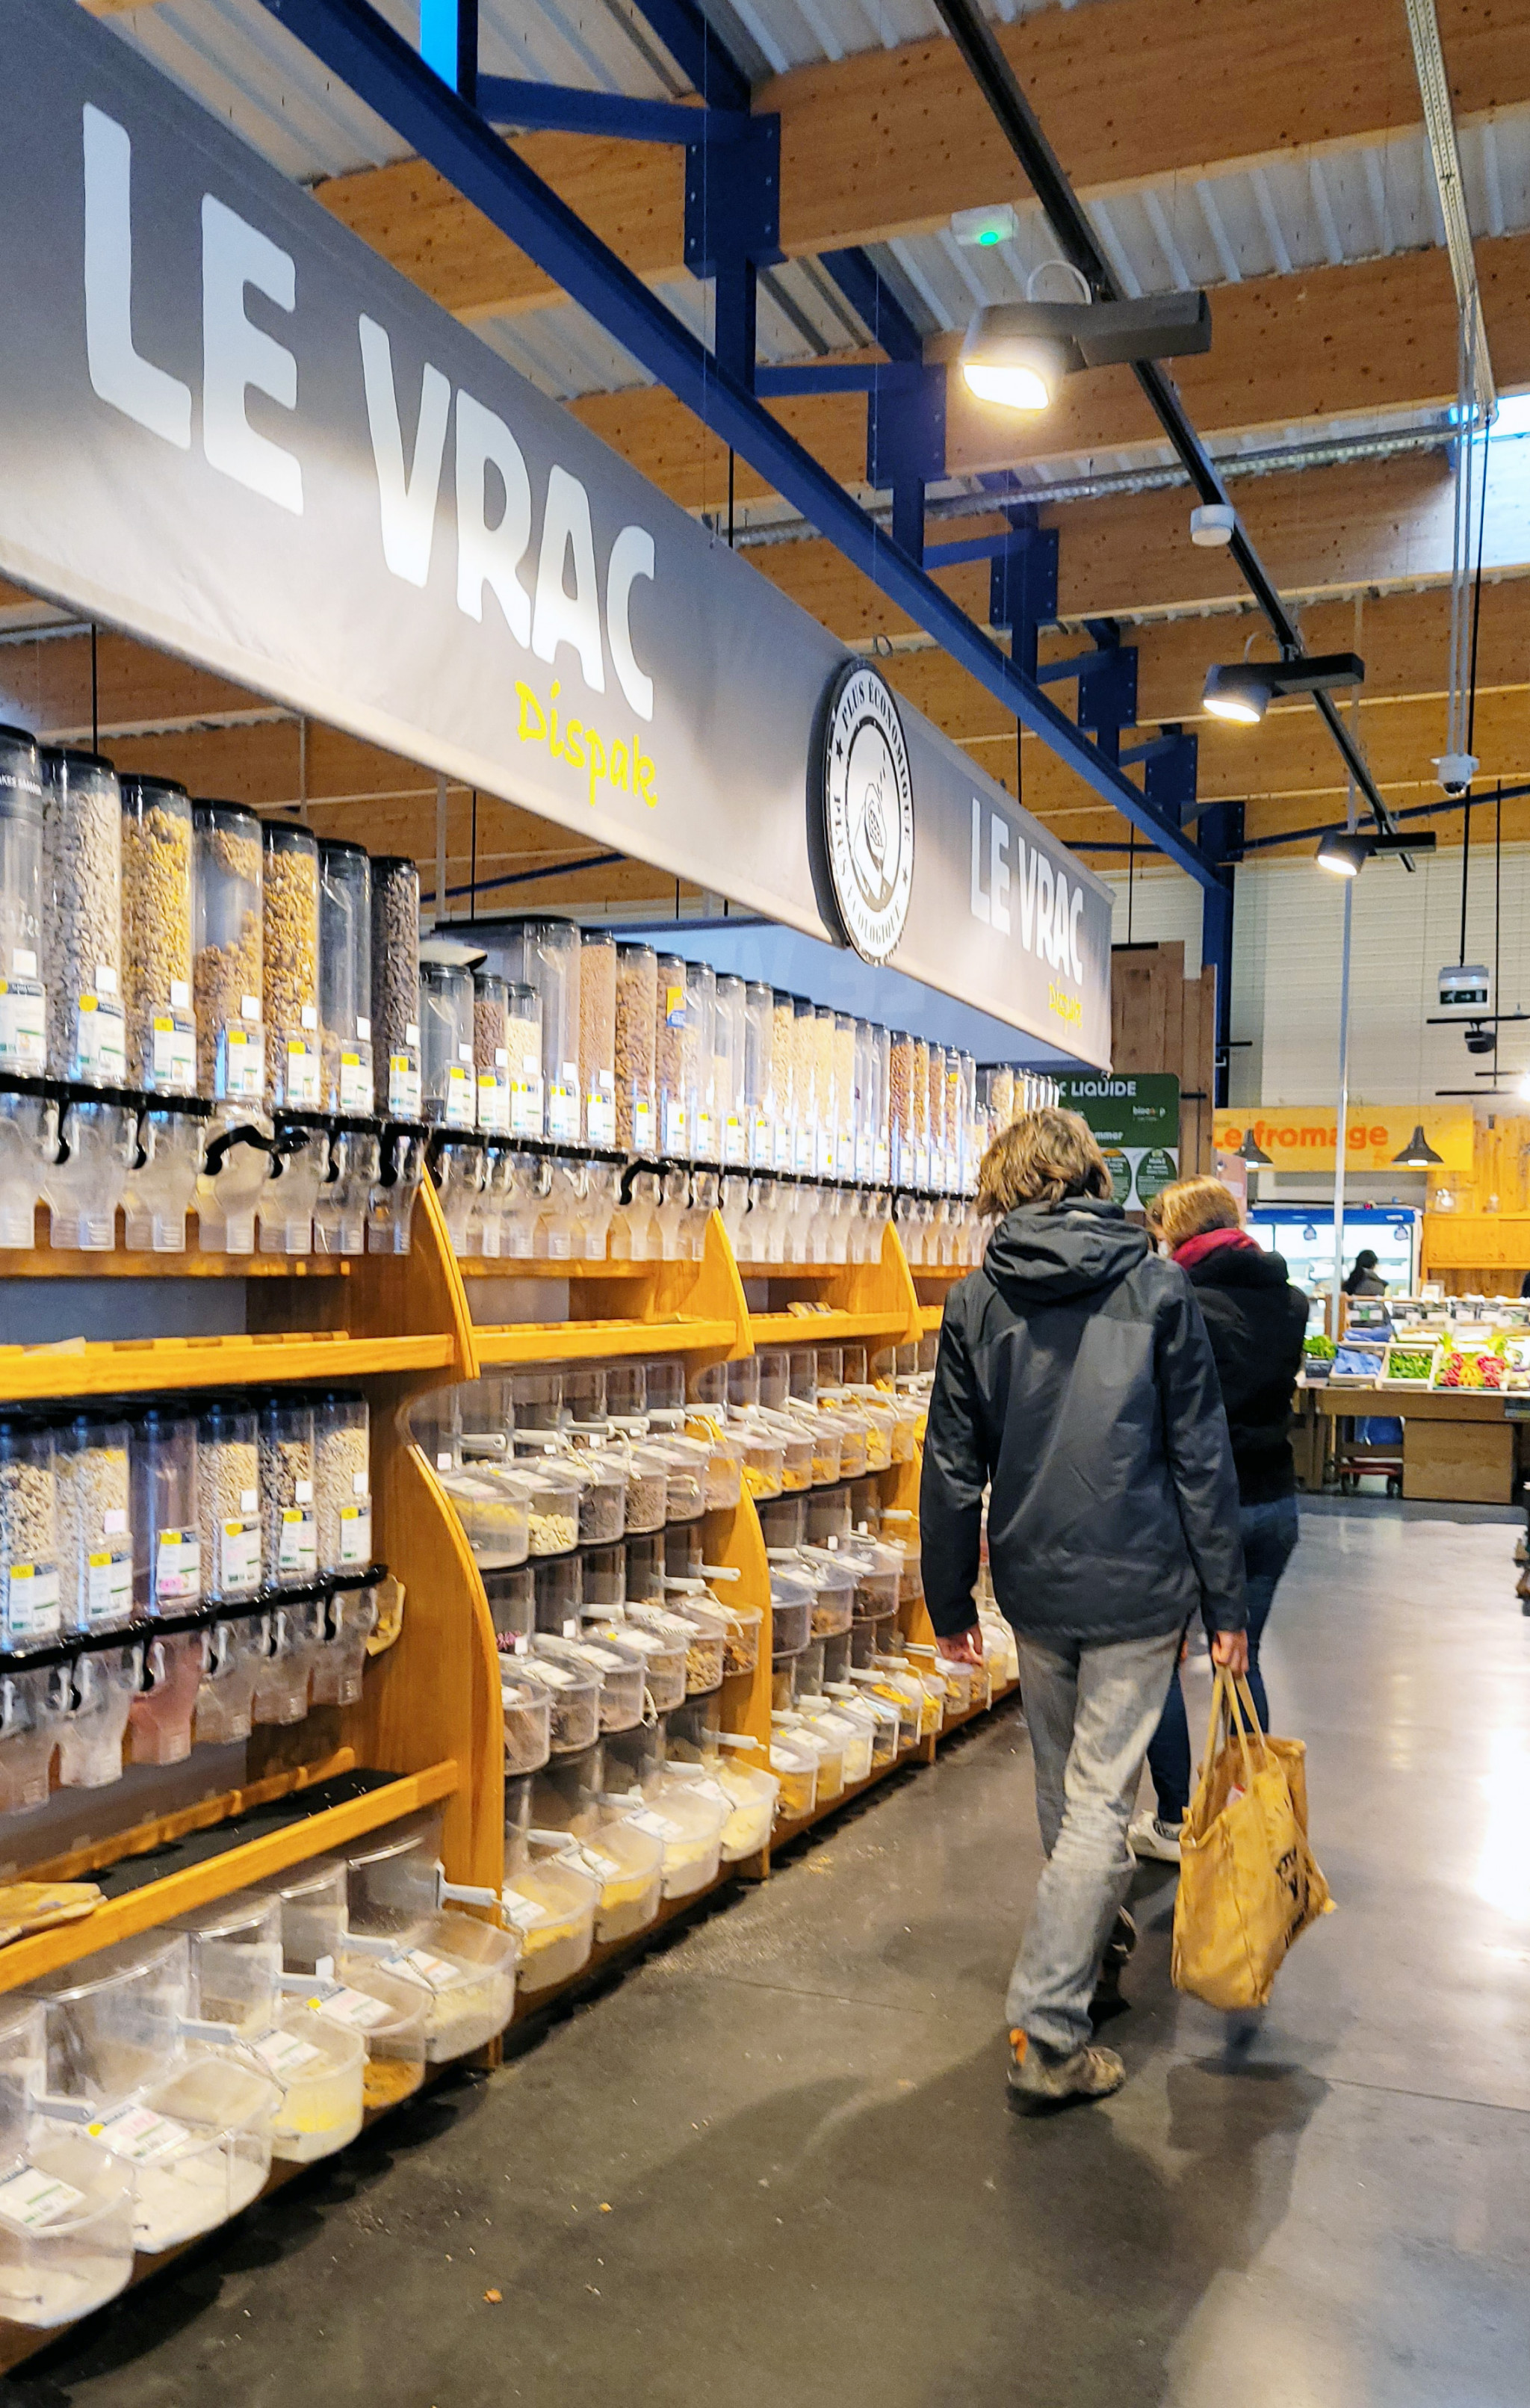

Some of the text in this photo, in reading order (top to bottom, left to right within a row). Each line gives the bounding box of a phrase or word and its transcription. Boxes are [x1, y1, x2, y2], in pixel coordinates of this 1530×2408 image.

[83, 102, 655, 722] LE VRAC
[515, 679, 658, 809] Dispak
[841, 681, 865, 732] PLUS
[971, 796, 1083, 986] LE VRAC
[1071, 1081, 1136, 1098] LIQUIDE
